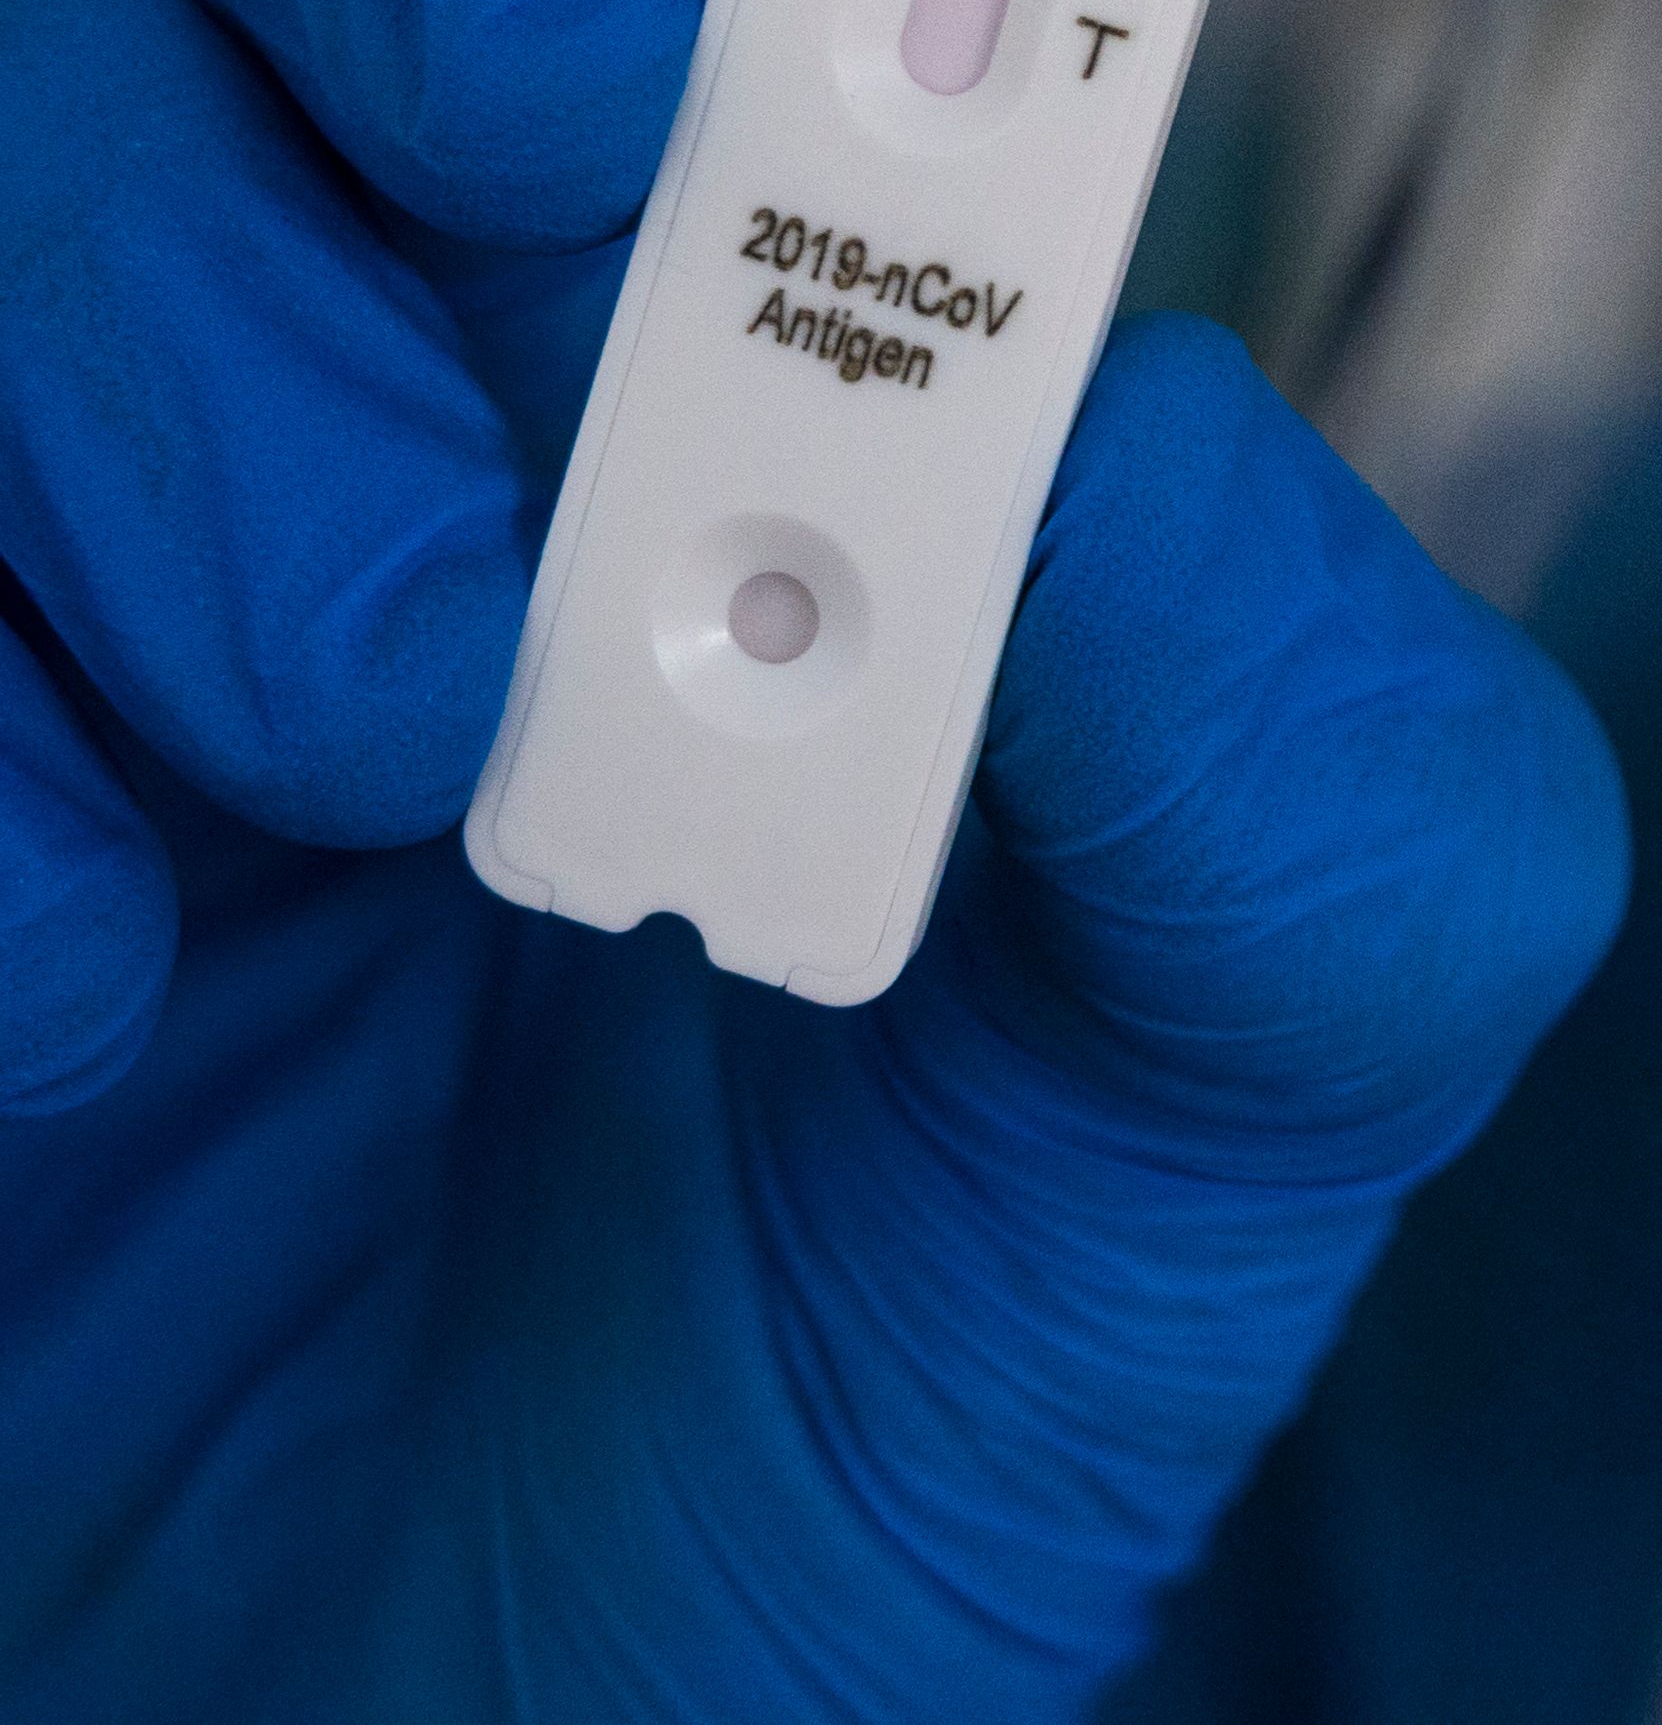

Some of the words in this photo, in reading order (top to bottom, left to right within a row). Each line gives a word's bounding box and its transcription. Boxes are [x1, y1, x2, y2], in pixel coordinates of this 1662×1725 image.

[1076, 15, 1130, 80] T
[740, 207, 1024, 338] 2019-nCoV
[748, 287, 935, 389] Antigen
